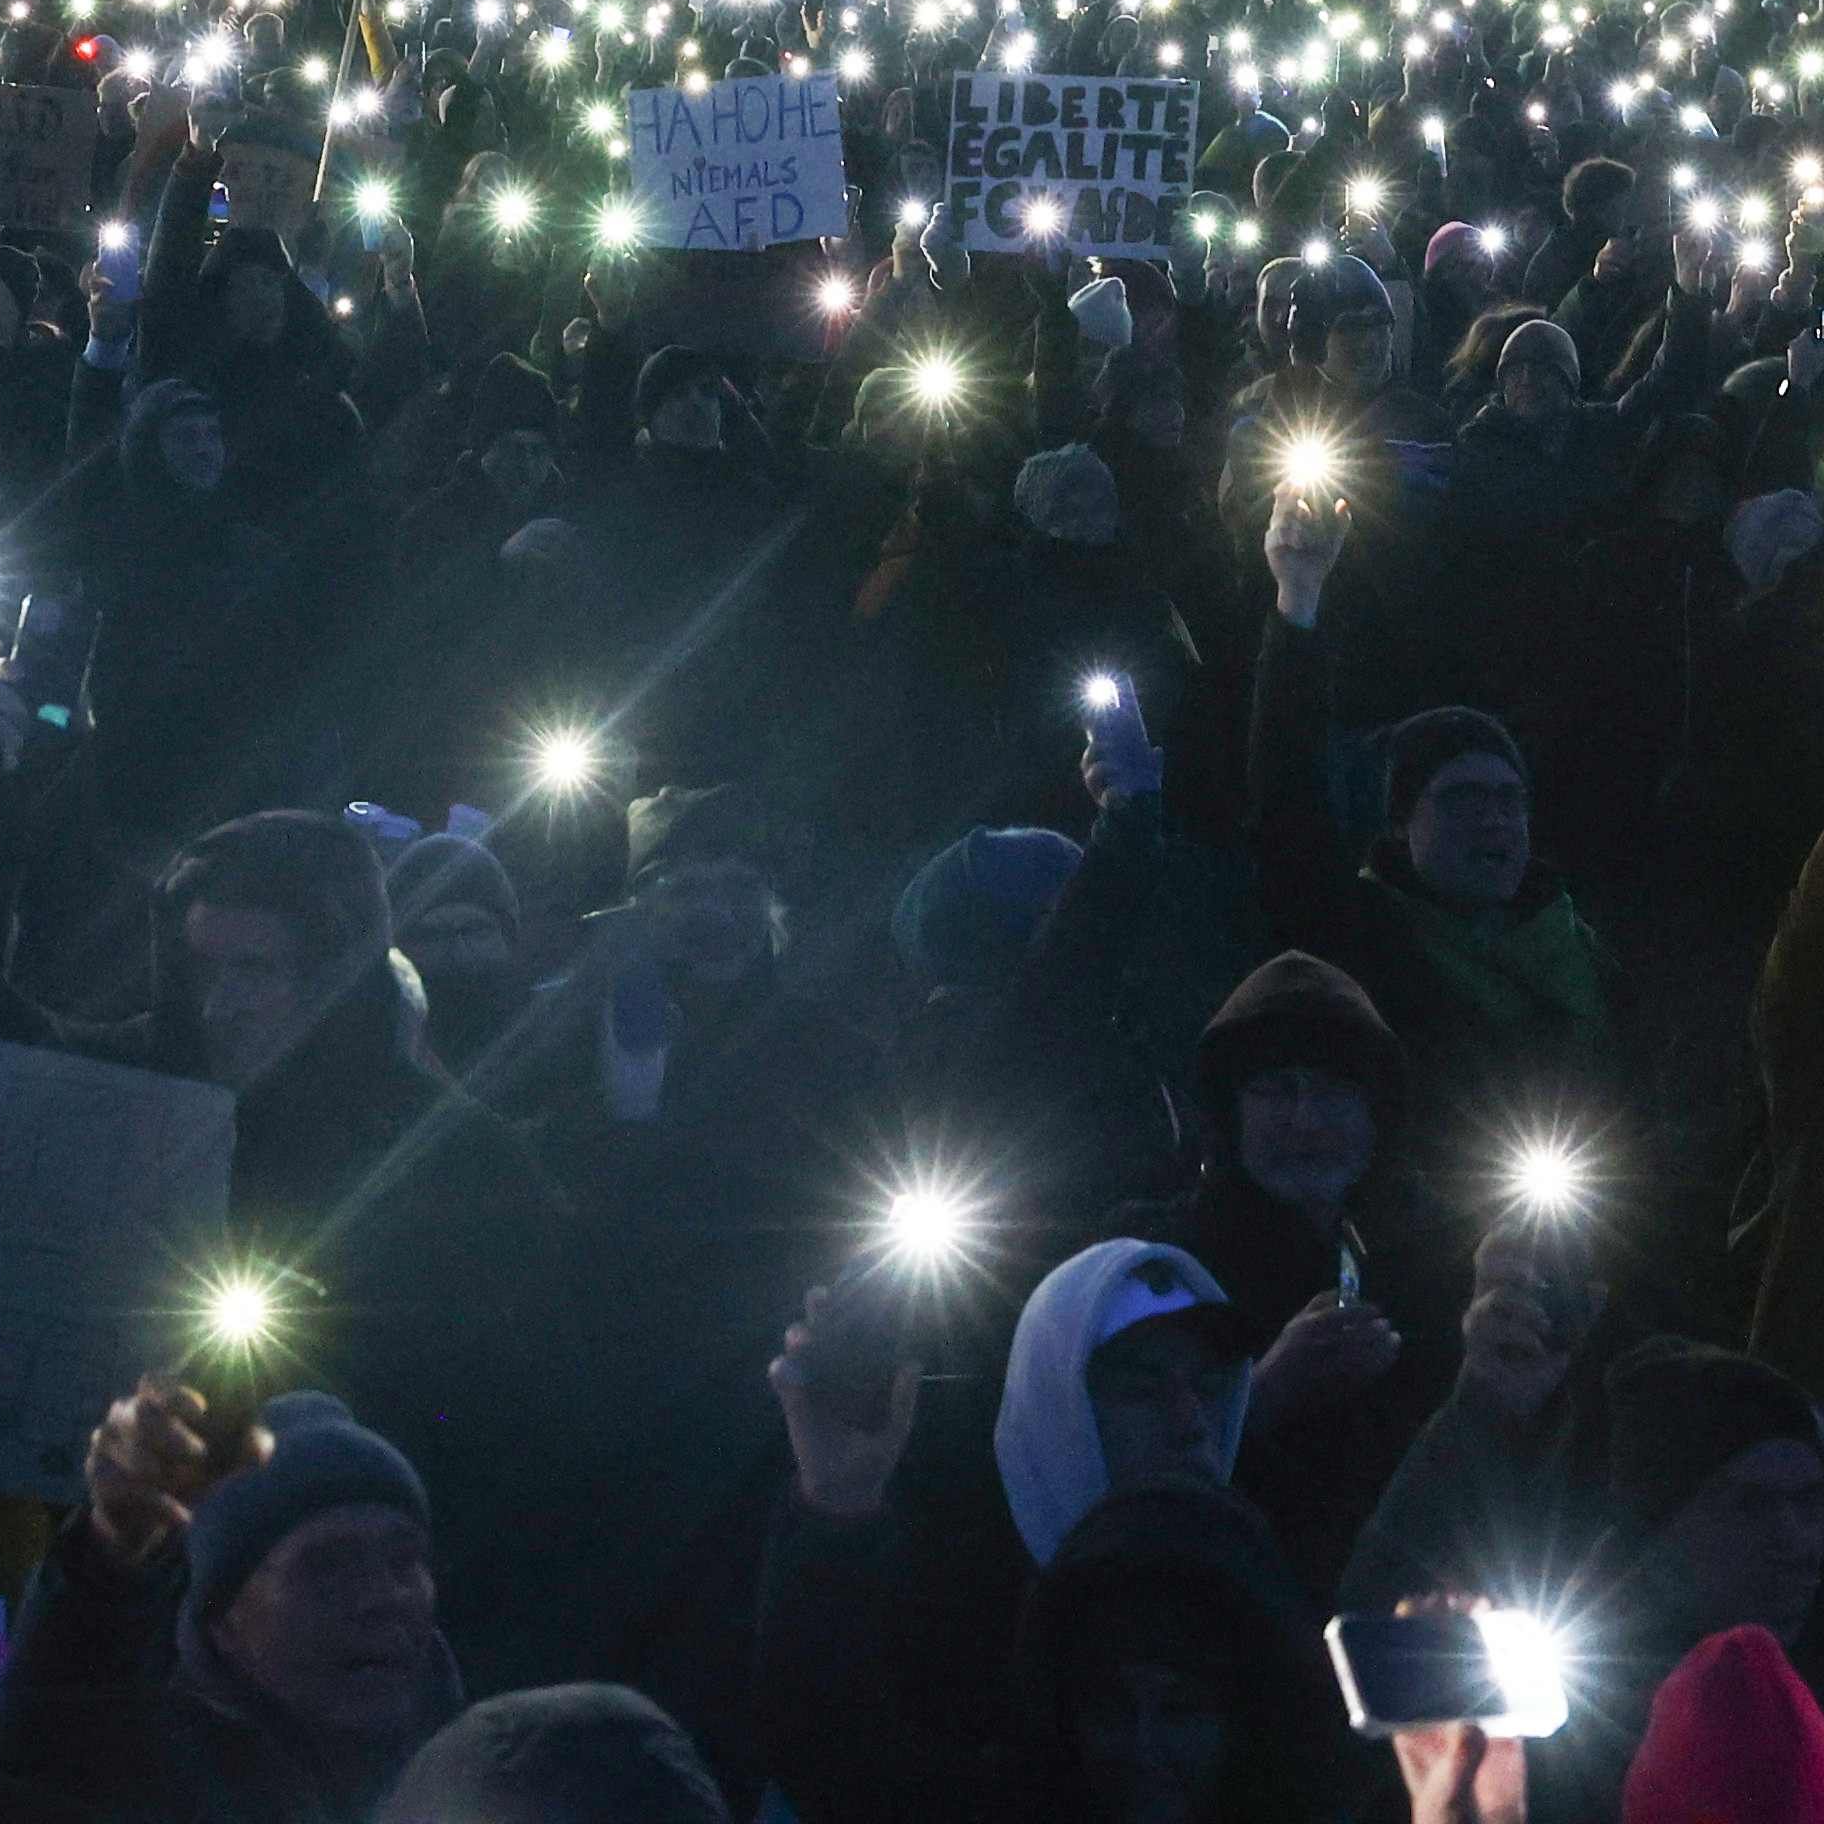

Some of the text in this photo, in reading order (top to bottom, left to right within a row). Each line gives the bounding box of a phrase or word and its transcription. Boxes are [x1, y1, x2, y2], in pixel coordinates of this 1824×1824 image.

[629, 74, 841, 155] HA HO HE
[671, 156, 799, 200] NIEMALS
[684, 191, 805, 250] AFD
